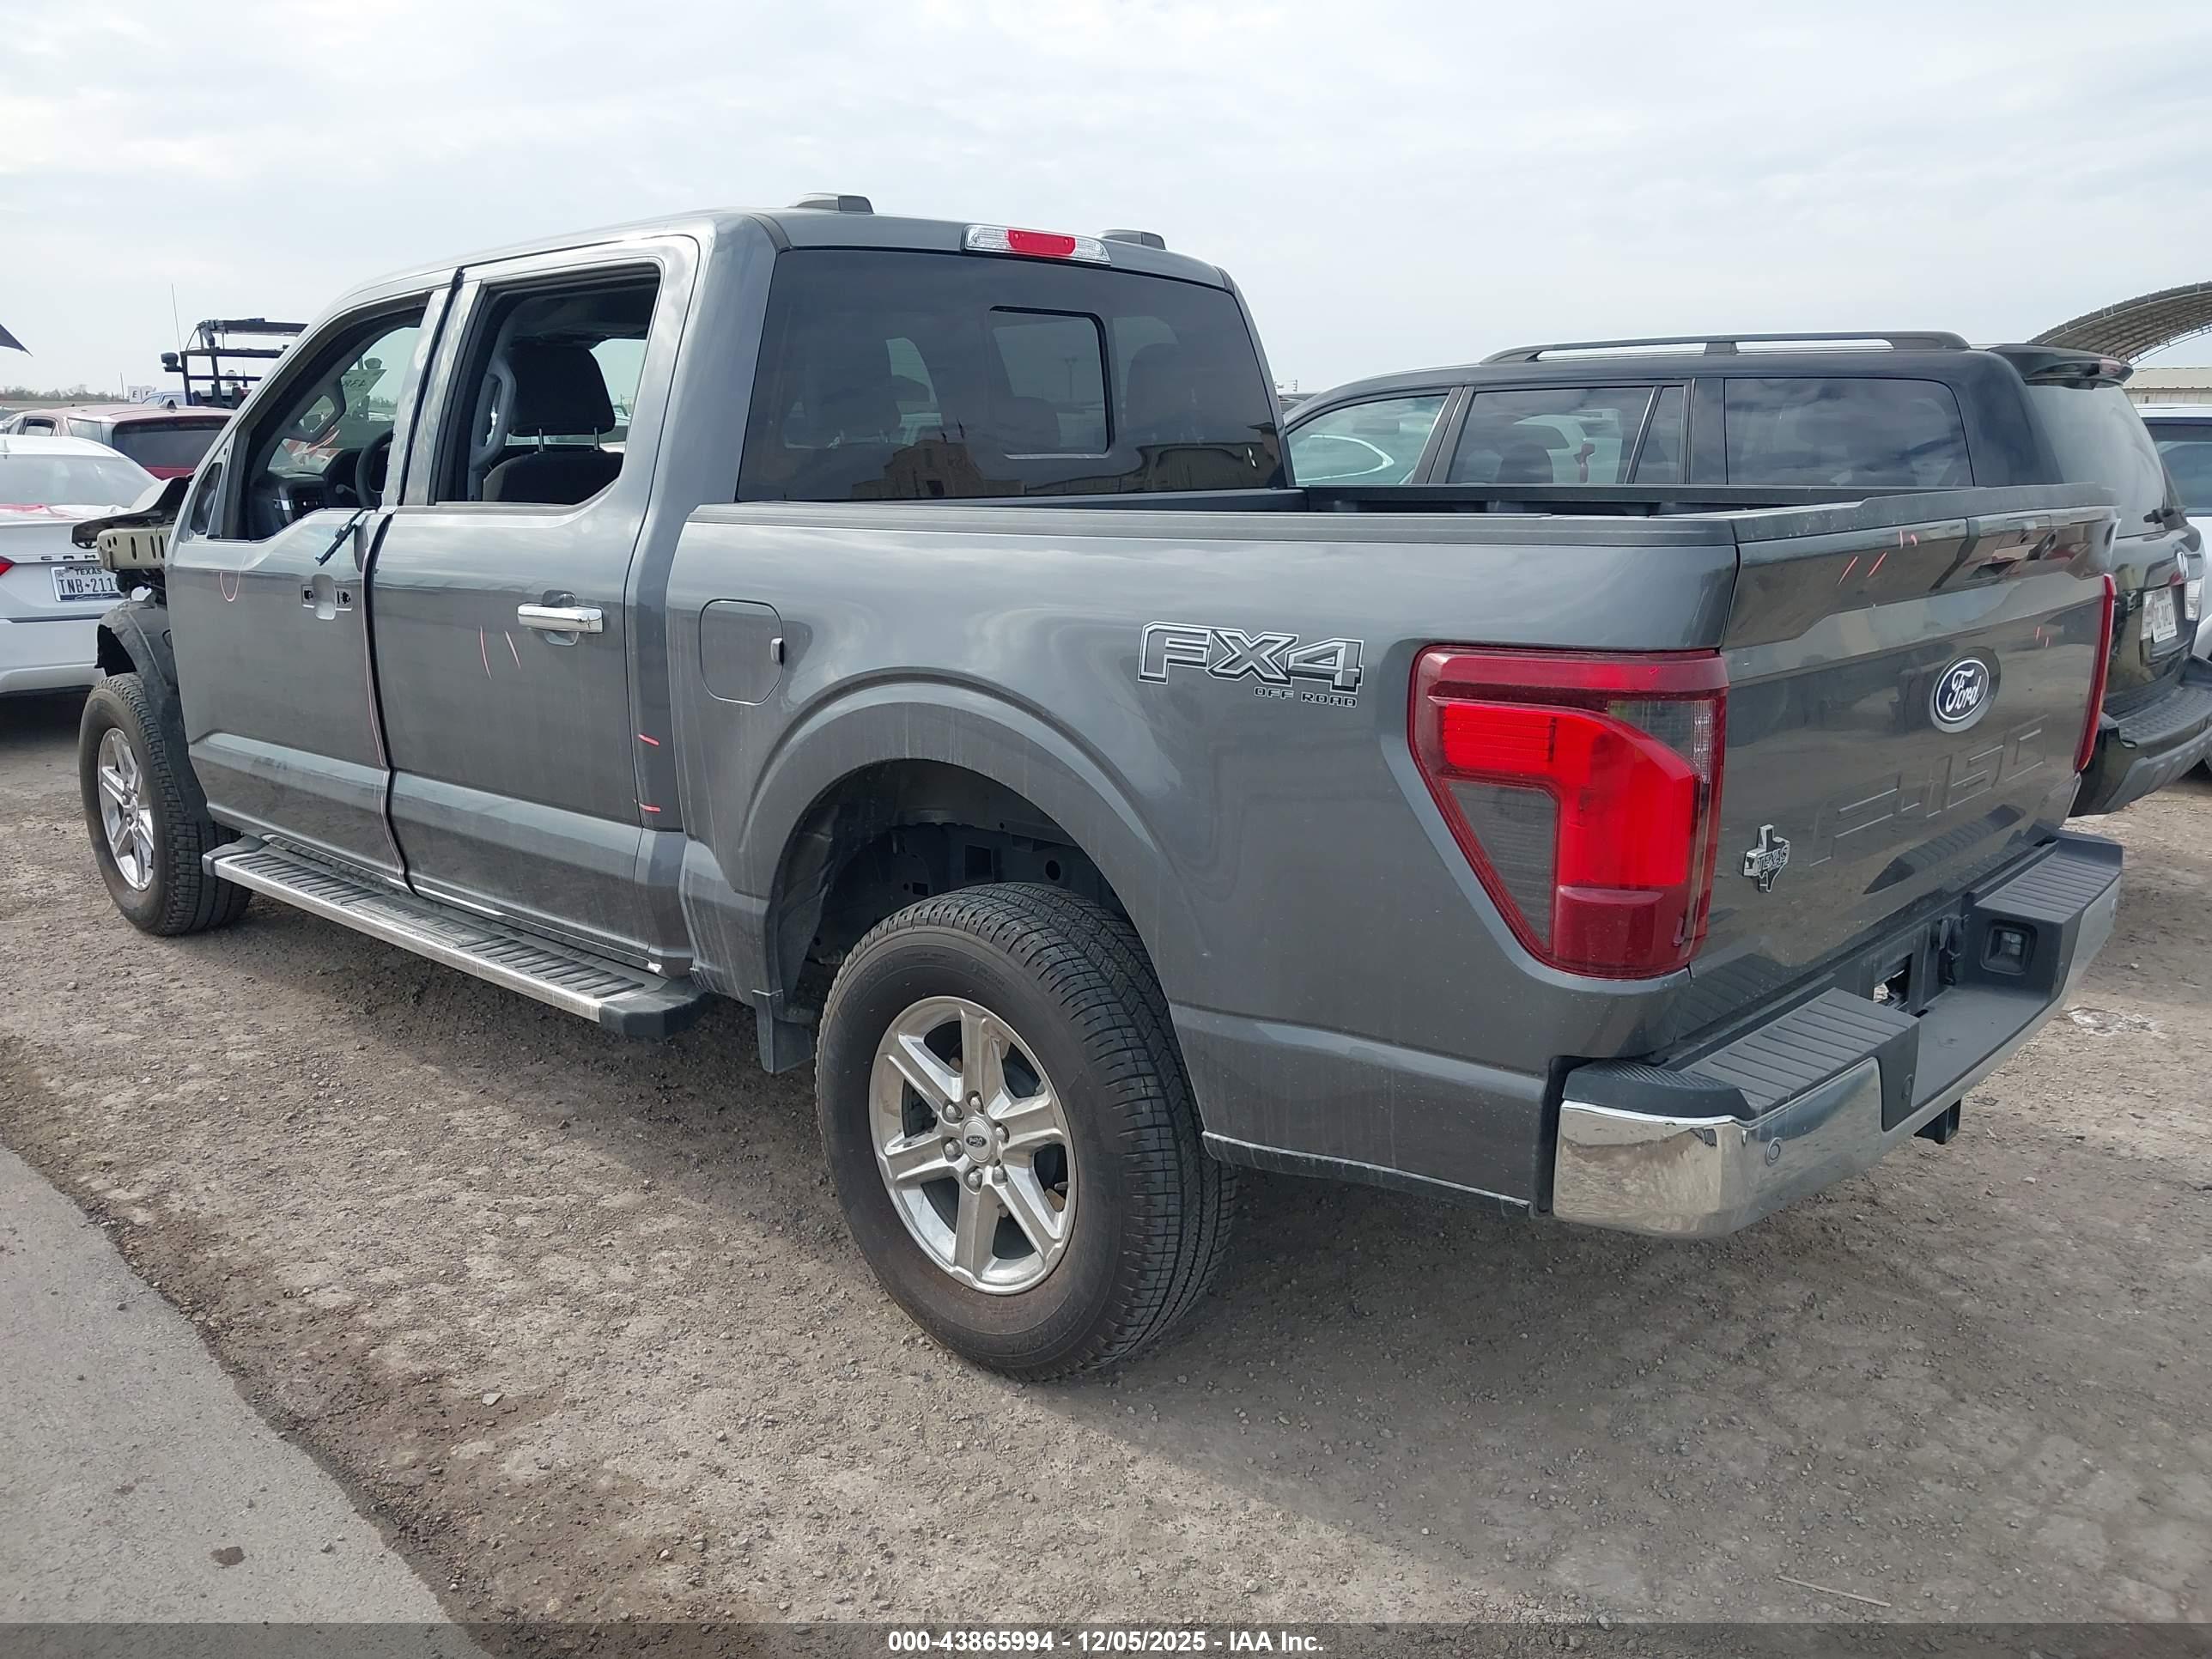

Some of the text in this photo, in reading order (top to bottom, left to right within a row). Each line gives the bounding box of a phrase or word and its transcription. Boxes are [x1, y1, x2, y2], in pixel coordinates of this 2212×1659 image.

[1138, 621, 1364, 694] FX4
[1254, 687, 1358, 708] OFF ROAD
[1945, 668, 1982, 713] Ford
[1758, 845, 1789, 872] TEXAS
